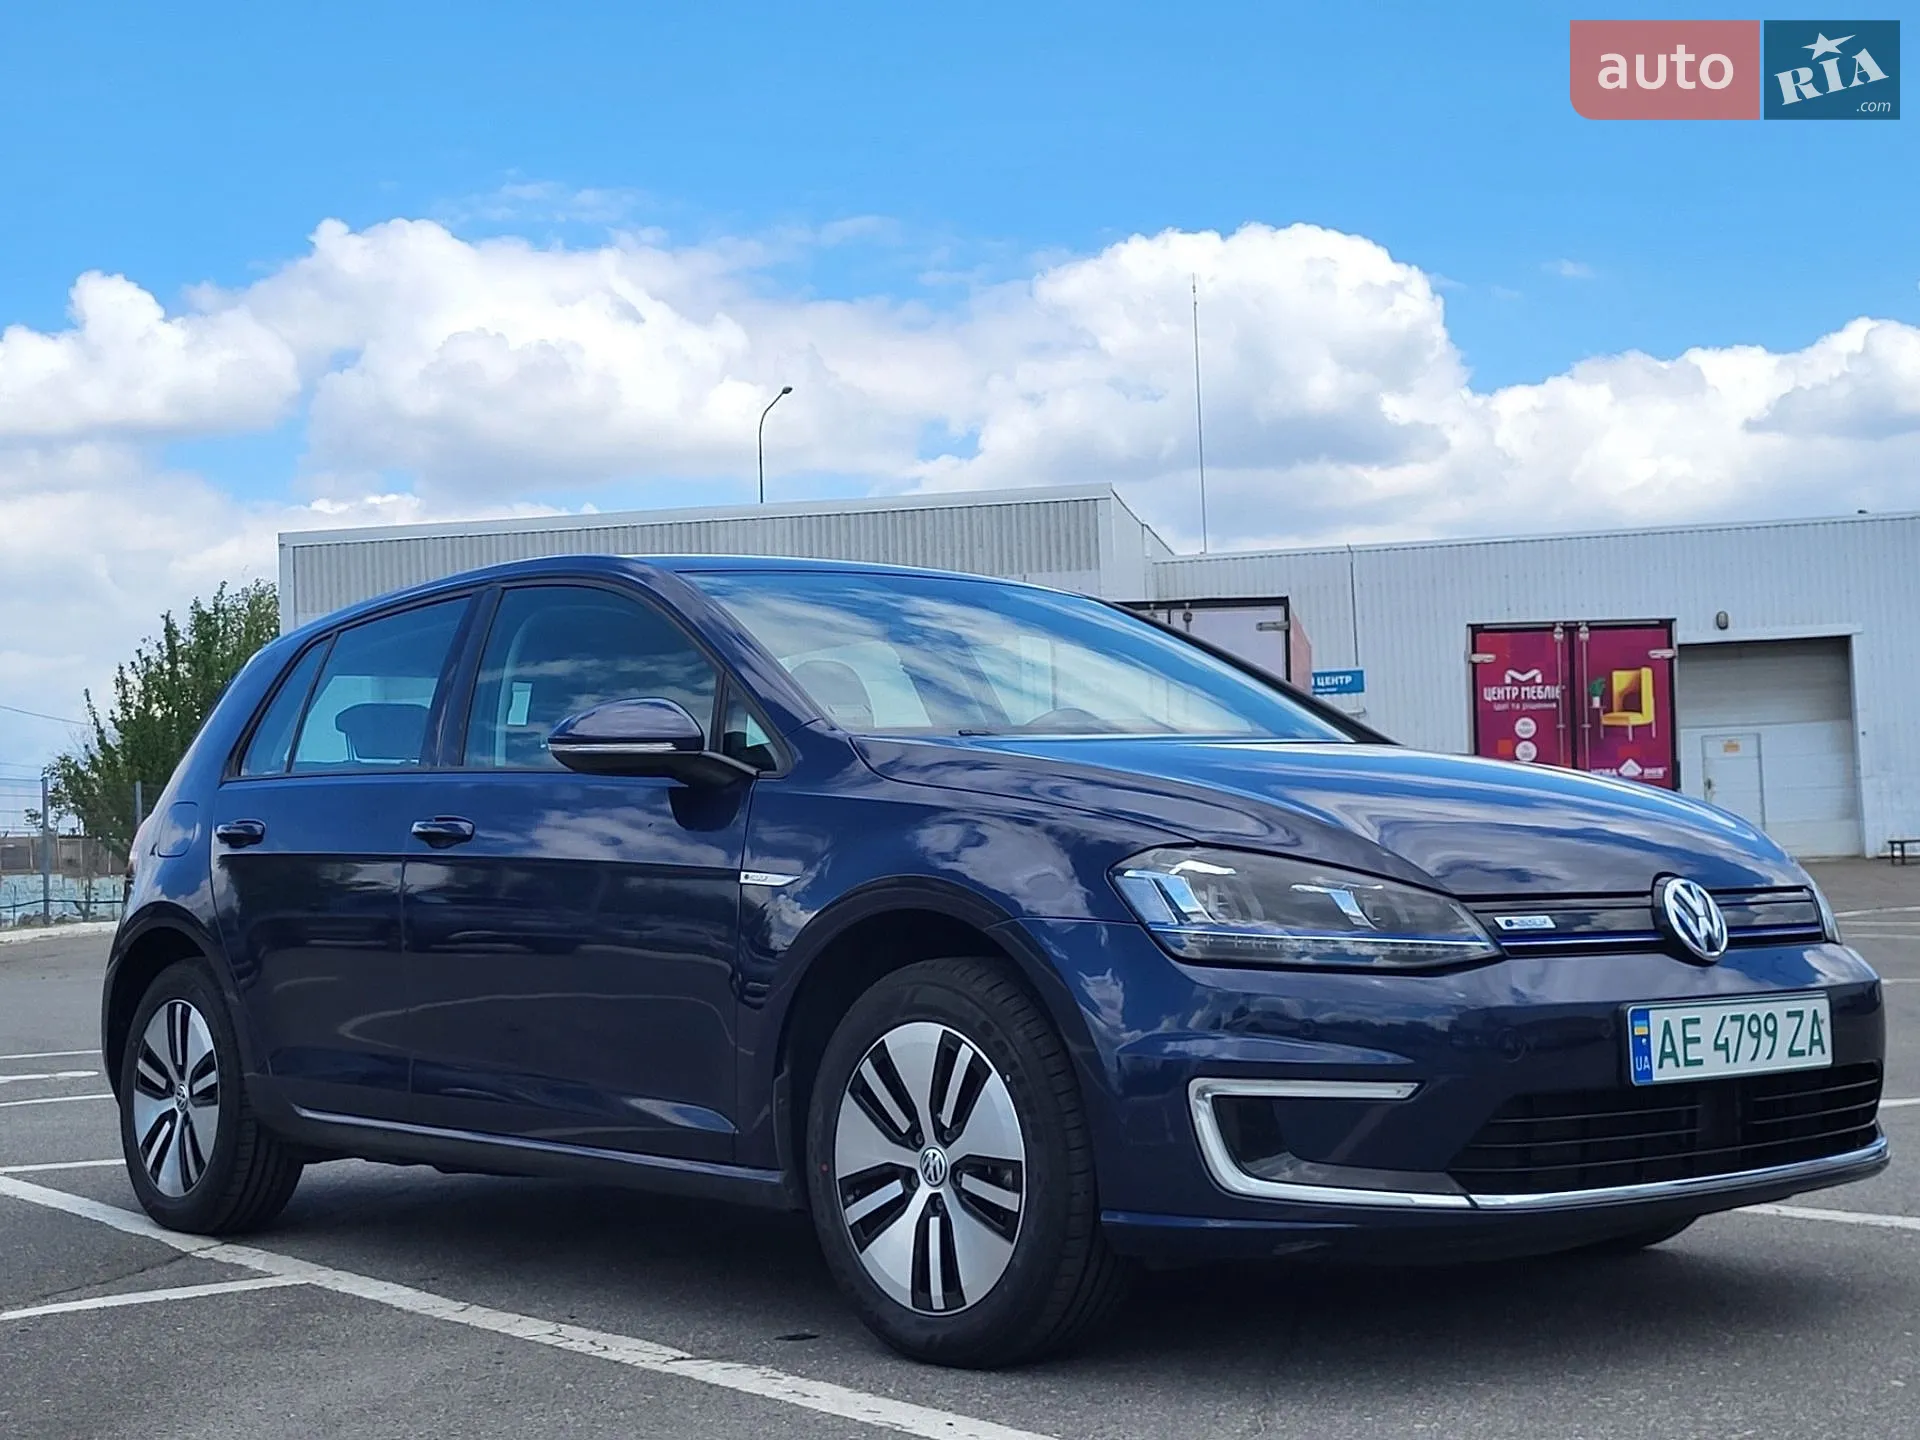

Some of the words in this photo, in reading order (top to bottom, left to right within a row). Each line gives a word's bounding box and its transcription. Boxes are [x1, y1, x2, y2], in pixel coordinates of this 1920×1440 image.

[1316, 675, 1353, 687] ЦЕНТР
[1483, 685, 1519, 702] ЦЕНТР
[1658, 1016, 1704, 1069] AE
[1713, 1011, 1778, 1064] 4799
[1785, 1008, 1826, 1058] ZA
[1635, 1055, 1651, 1072] UA
